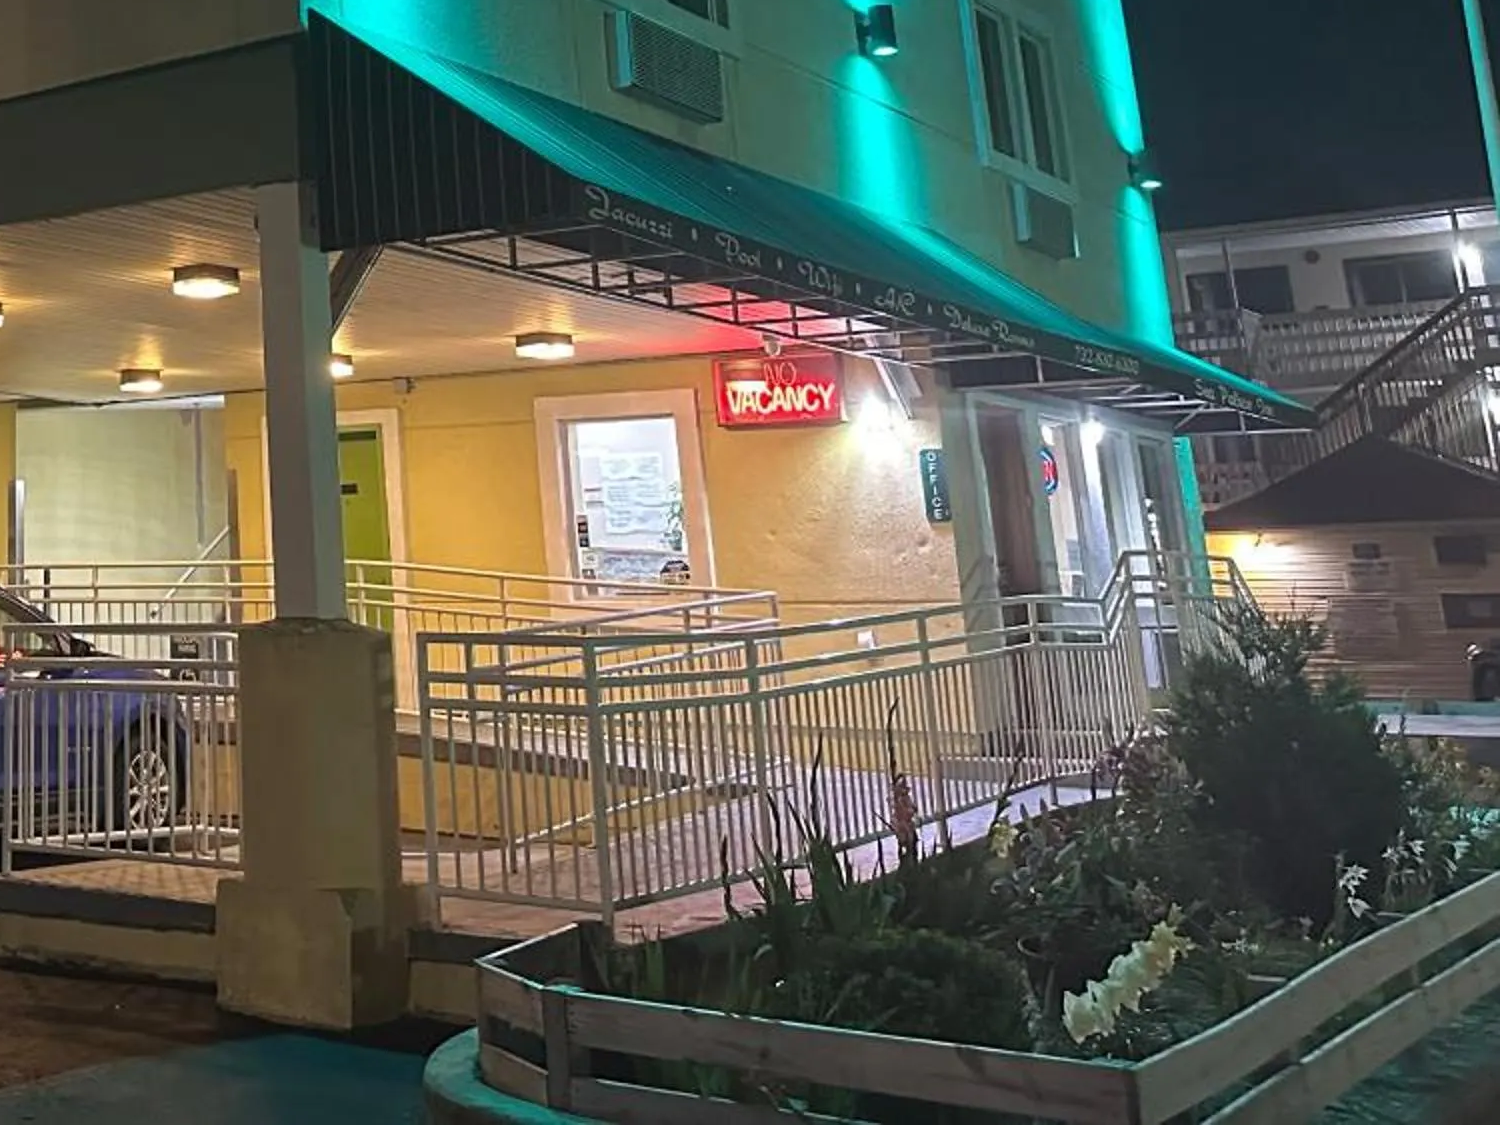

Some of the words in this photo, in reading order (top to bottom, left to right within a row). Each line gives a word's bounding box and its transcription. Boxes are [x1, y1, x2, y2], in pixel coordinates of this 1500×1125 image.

[585, 185, 673, 239] Jacuzzi
[715, 232, 761, 268] Pool
[726, 381, 836, 415] VACANCY
[763, 362, 798, 386] NO
[925, 450, 944, 521] OFFICE
